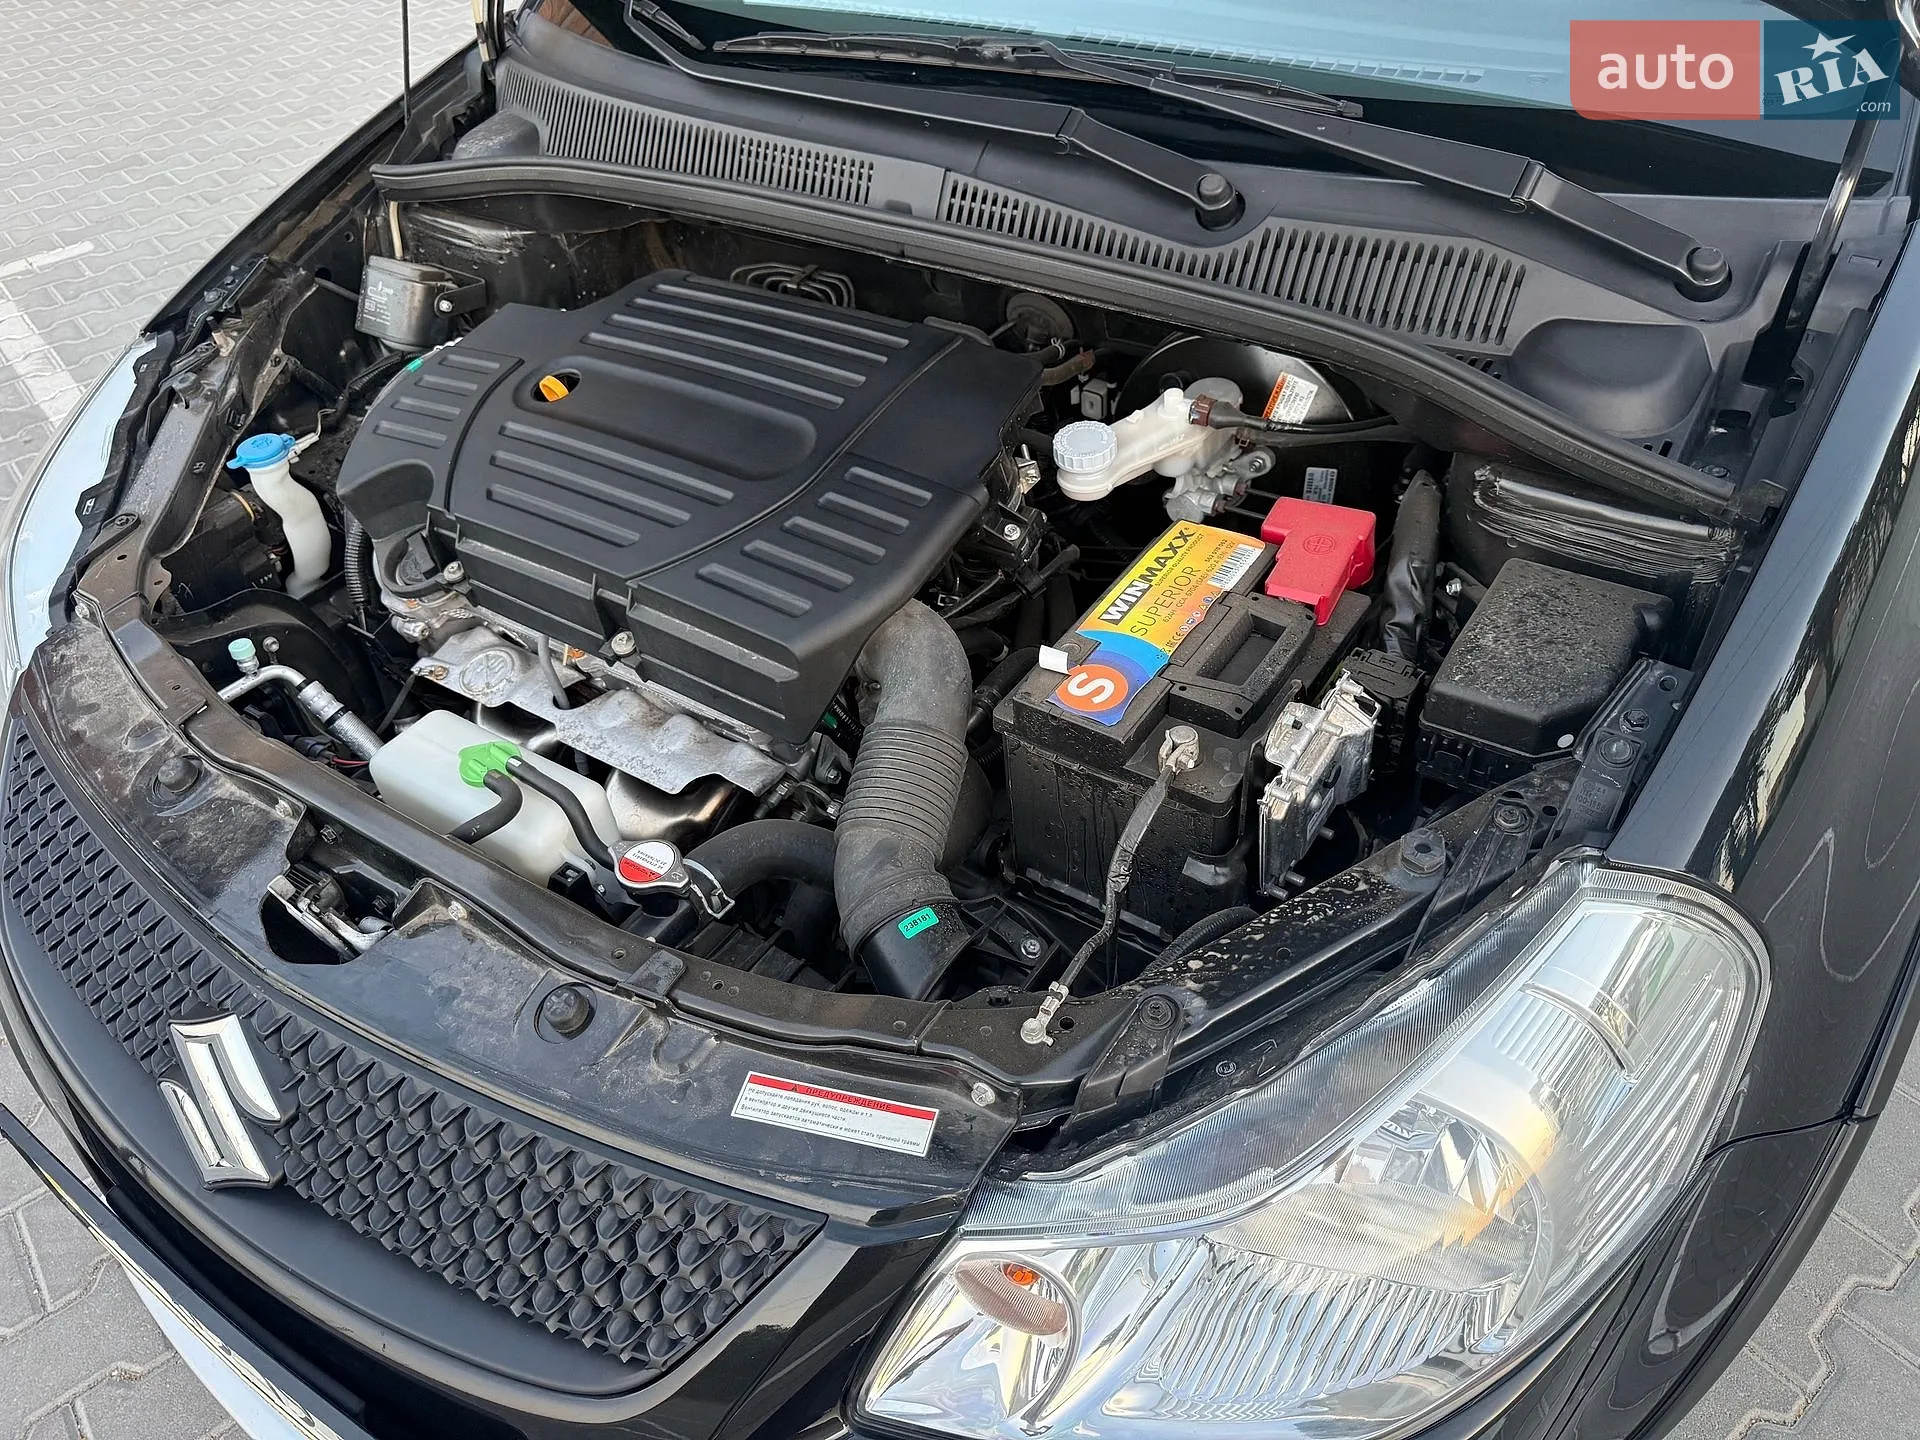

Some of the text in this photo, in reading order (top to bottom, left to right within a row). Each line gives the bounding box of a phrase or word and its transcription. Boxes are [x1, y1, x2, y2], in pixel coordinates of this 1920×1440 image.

[1099, 530, 1197, 620] WINMAXX
[1130, 566, 1201, 636] SUPERIOR
[1067, 672, 1115, 704] S
[806, 1088, 892, 1111] ПРЕДУПРЕЖДЕНИЕ
